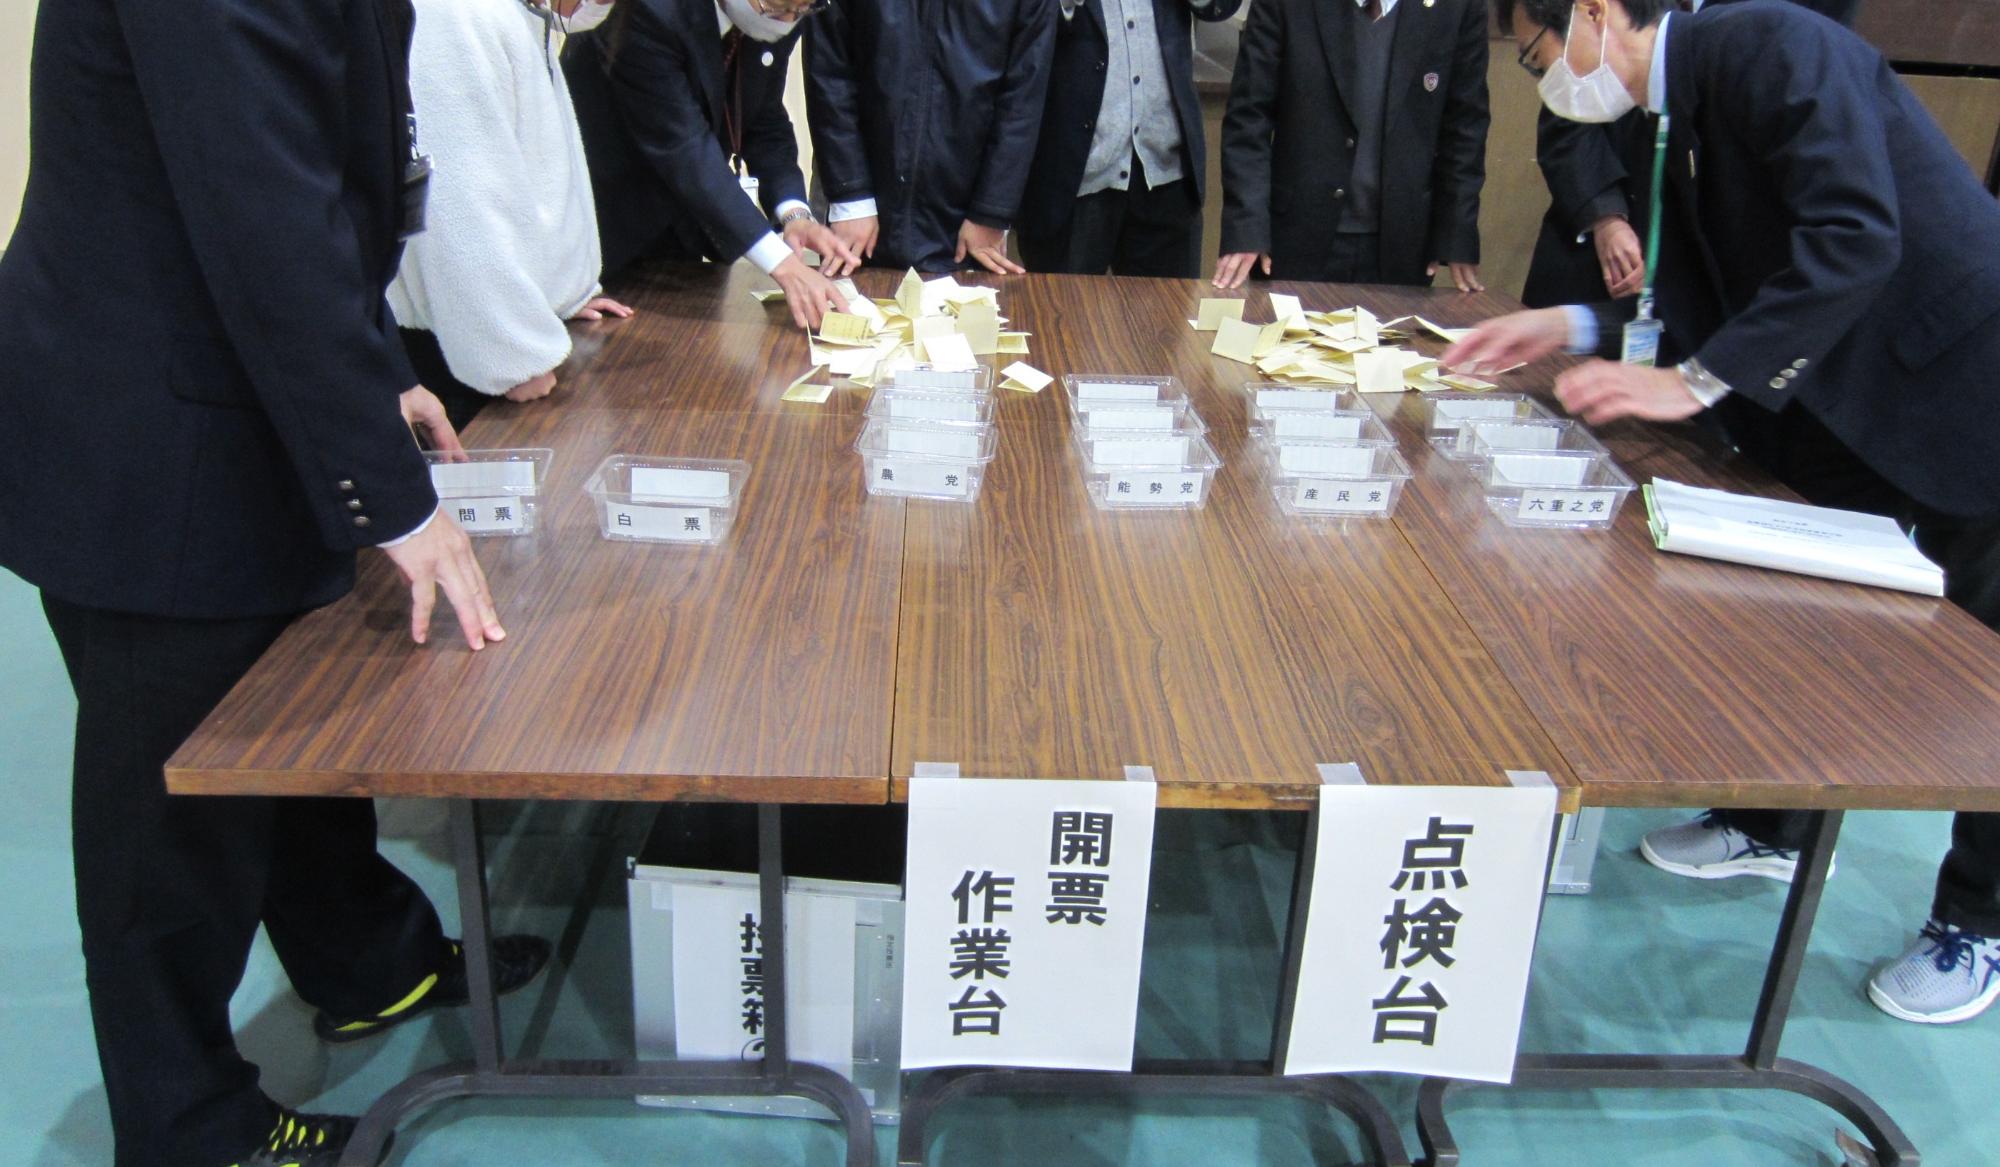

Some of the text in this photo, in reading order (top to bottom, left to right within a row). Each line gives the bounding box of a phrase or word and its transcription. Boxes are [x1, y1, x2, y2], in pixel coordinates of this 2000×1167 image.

[1117, 481, 1194, 495] 能勢党
[1303, 487, 1382, 502] 産民党
[1528, 498, 1605, 514] 六重之党
[617, 513, 701, 531] 白票
[1045, 810, 1114, 926] 開票
[1371, 815, 1474, 1046] 点検台
[948, 869, 1015, 1037] 作業台
